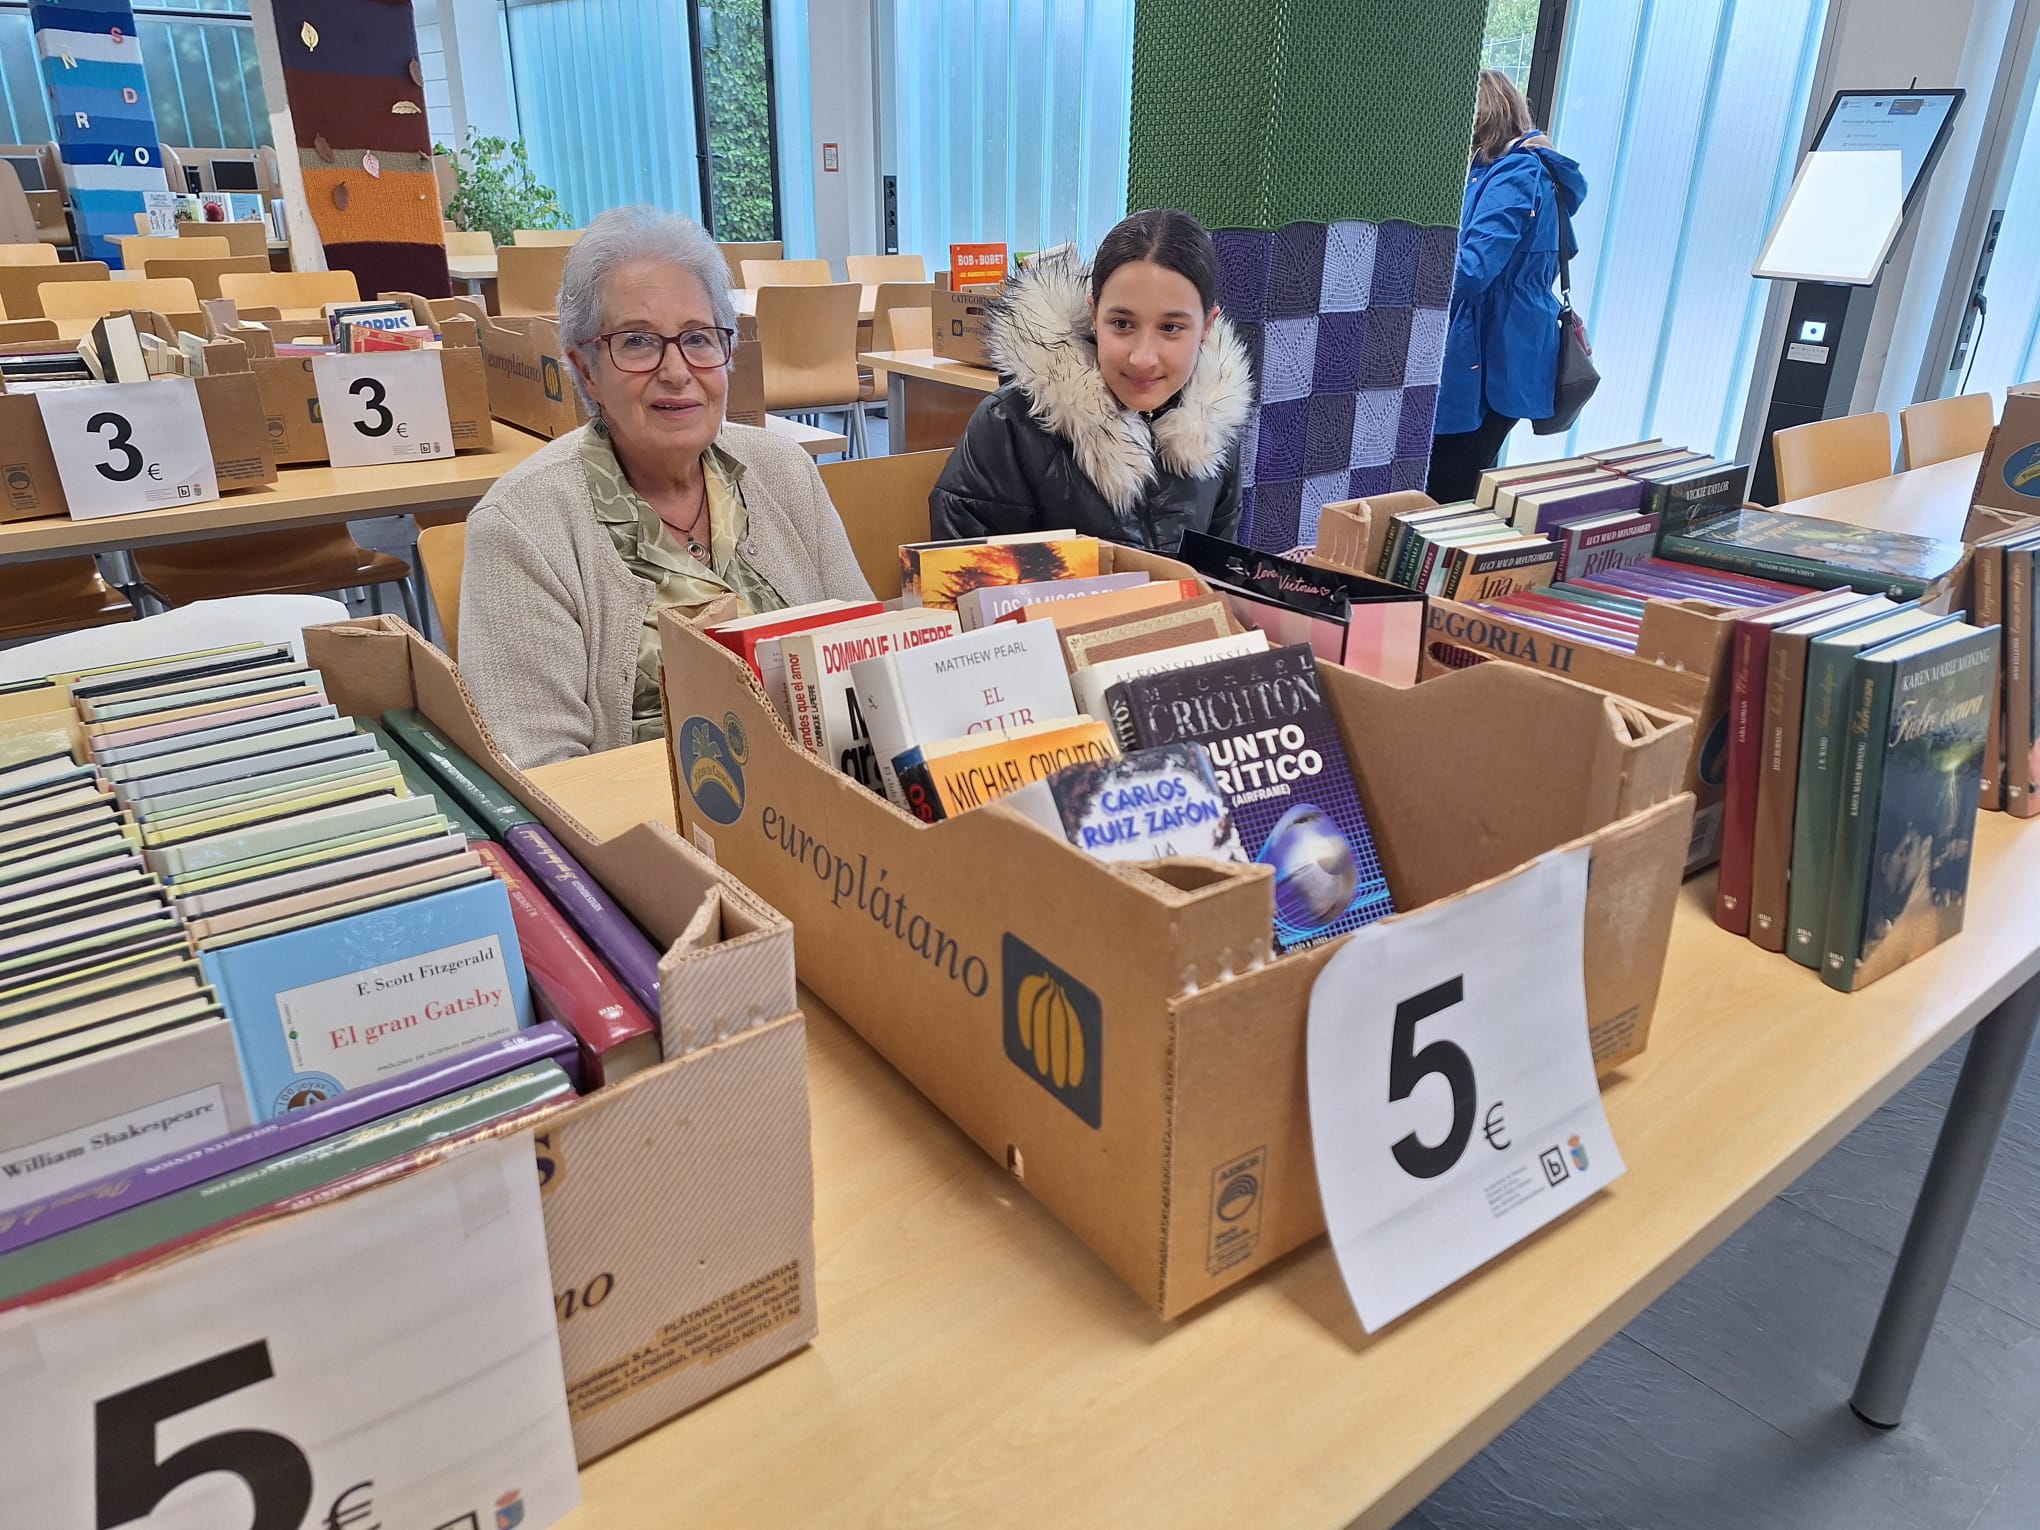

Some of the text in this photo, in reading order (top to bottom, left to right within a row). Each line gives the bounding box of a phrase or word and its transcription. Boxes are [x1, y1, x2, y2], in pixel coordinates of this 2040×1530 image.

[123, 88, 138, 103] D
[75, 112, 90, 128] R
[957, 255, 974, 266] BOB
[979, 254, 1004, 265] BOBET
[488, 352, 542, 384] europlátano
[349, 377, 394, 437] 3
[396, 423, 409, 438] €
[86, 412, 163, 481] 3 €
[1707, 481, 1730, 495] TAYLOR
[1278, 575, 1320, 594] Victoria
[1428, 605, 1539, 663] EGORIA
[788, 653, 804, 677] amor
[935, 641, 1027, 674] MATTHEW PEARL
[1903, 647, 1991, 691] KAREN MARIE MONING
[790, 676, 805, 692] el
[796, 691, 811, 713] que
[983, 686, 1005, 706] EL
[1149, 671, 1322, 743] CRICHTON
[1216, 749, 1323, 795] RÍTICO
[1101, 777, 1187, 813] CARLOS
[1231, 784, 1291, 808] (AIRFRAME)
[1081, 796, 1220, 850] RUIZ ZAFÓN
[762, 806, 989, 997] europlátano
[357, 947, 495, 997] F. Scott Fitzgerald
[328, 1025, 357, 1051] El
[365, 1014, 418, 1046] gran
[424, 987, 502, 1022] Gatsby
[1389, 973, 1478, 1180] 5
[1482, 1101, 1511, 1150] €
[1, 1101, 215, 1179] William Shakespeare
[664, 1259, 799, 1335] PLÁTANO DE CANARIAS
[567, 1357, 629, 1395] uroplátano
[704, 1312, 722, 1326] Los
[782, 1271, 799, 1286] 118
[642, 1348, 675, 1369] Palma
[711, 1307, 755, 1334] Canarias
[709, 1336, 739, 1359] PESO
[742, 1319, 772, 1341] NETO
[94, 1338, 381, 1530] 5 €
